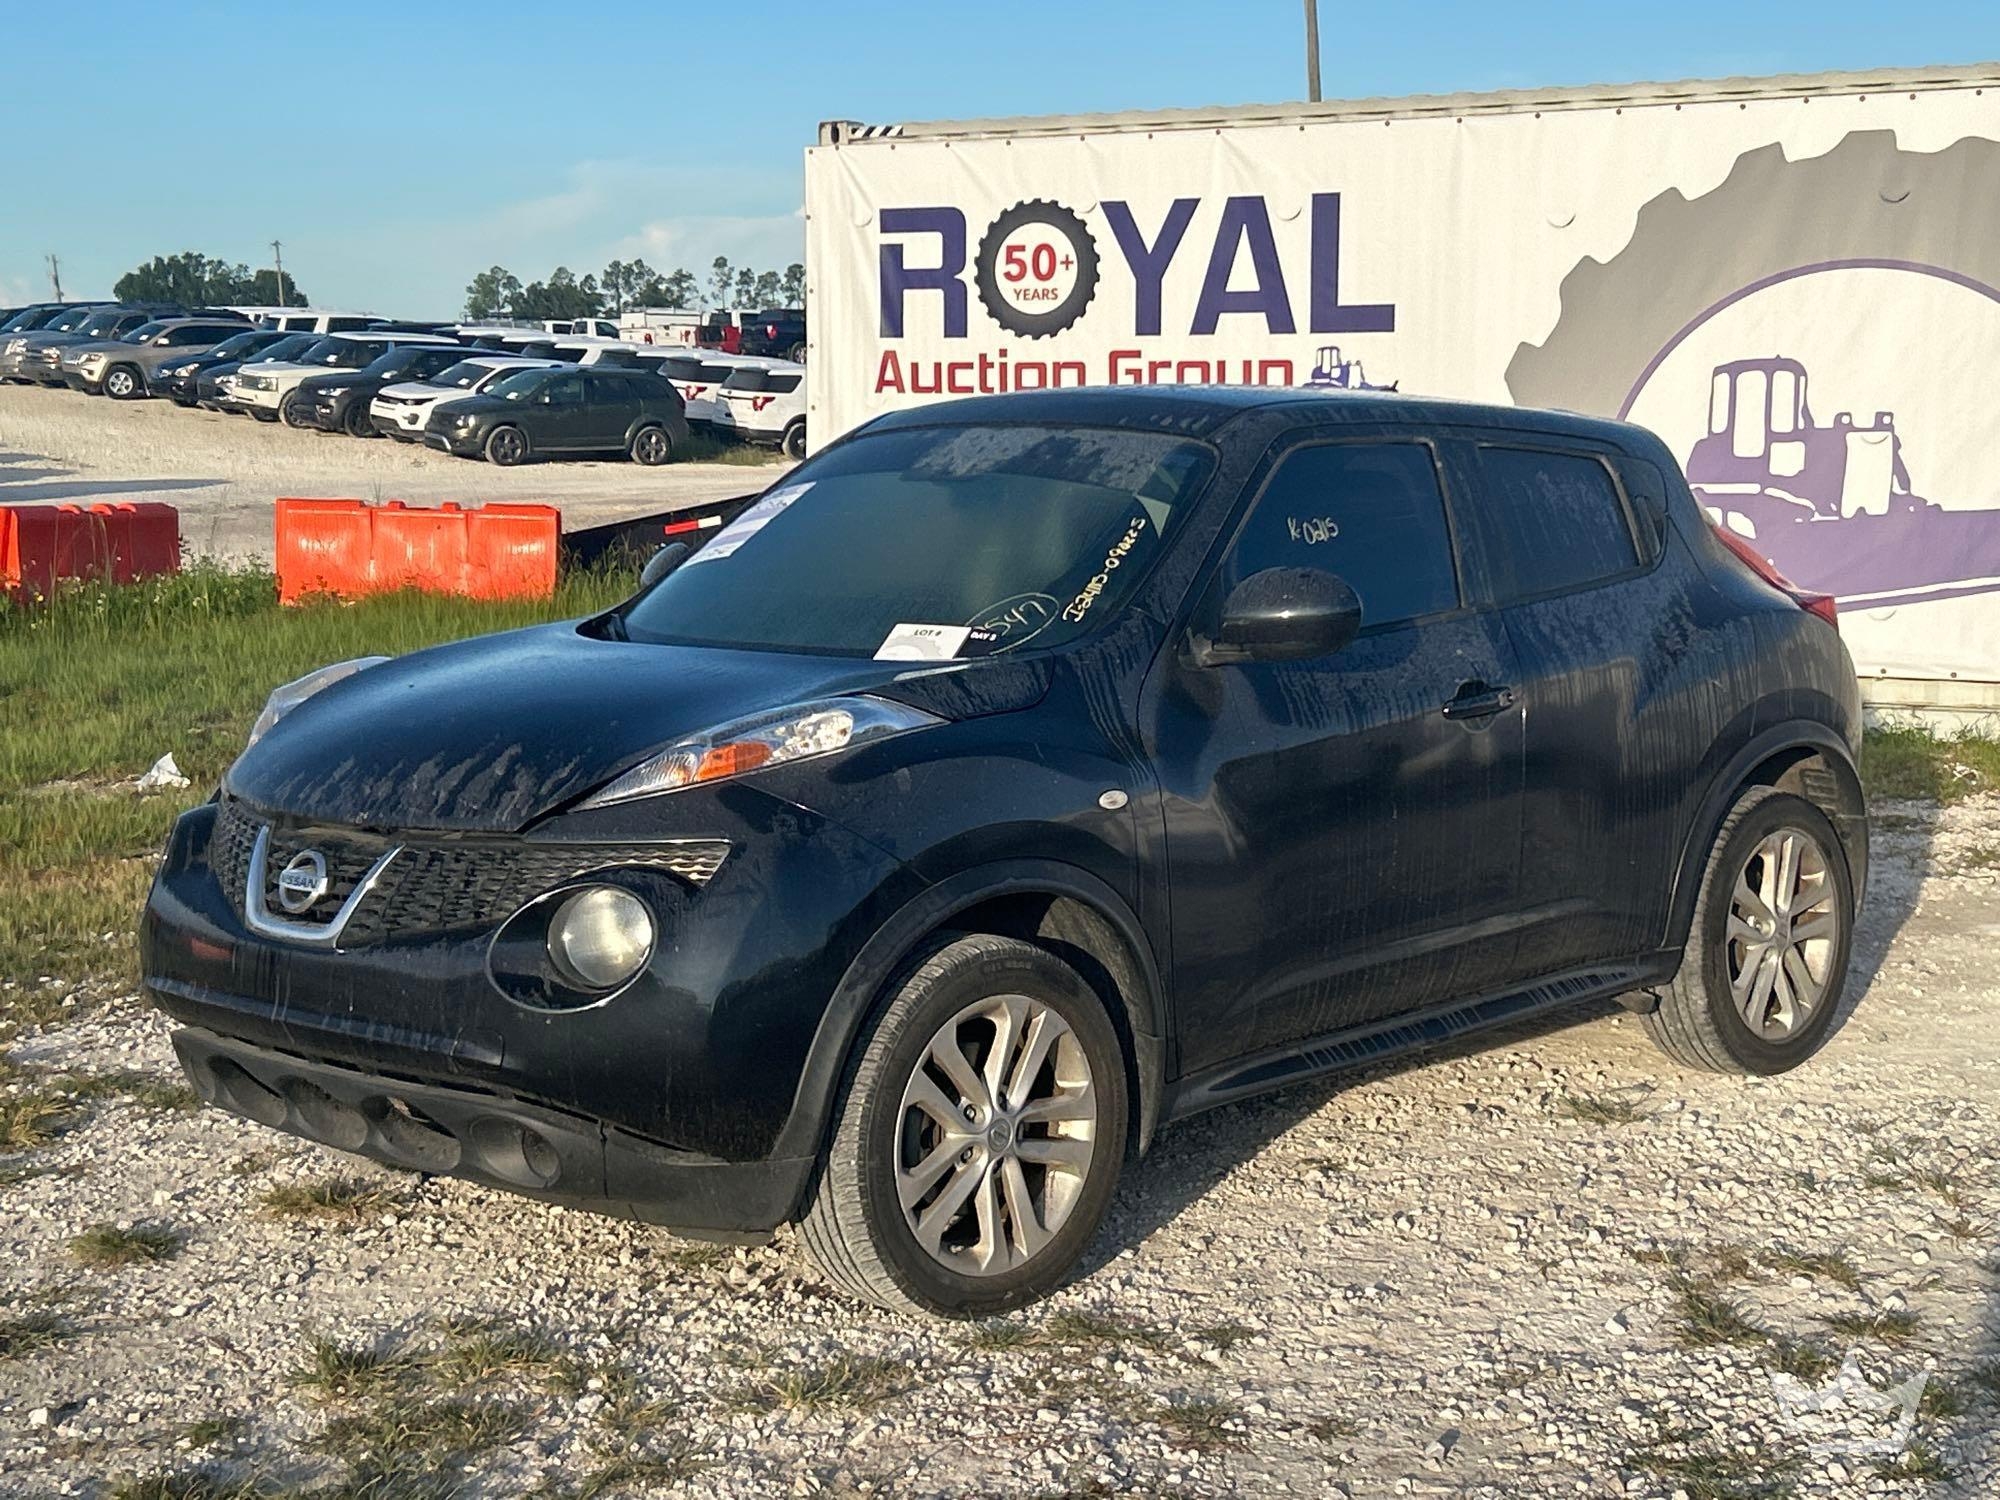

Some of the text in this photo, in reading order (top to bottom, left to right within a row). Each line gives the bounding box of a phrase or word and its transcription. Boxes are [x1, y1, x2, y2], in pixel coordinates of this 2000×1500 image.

[879, 192, 1395, 340] ROYAL
[1003, 243, 1074, 282] 50+
[1013, 288, 1059, 301] YEARS
[875, 348, 1086, 394] Auction
[914, 629, 934, 637] LOT
